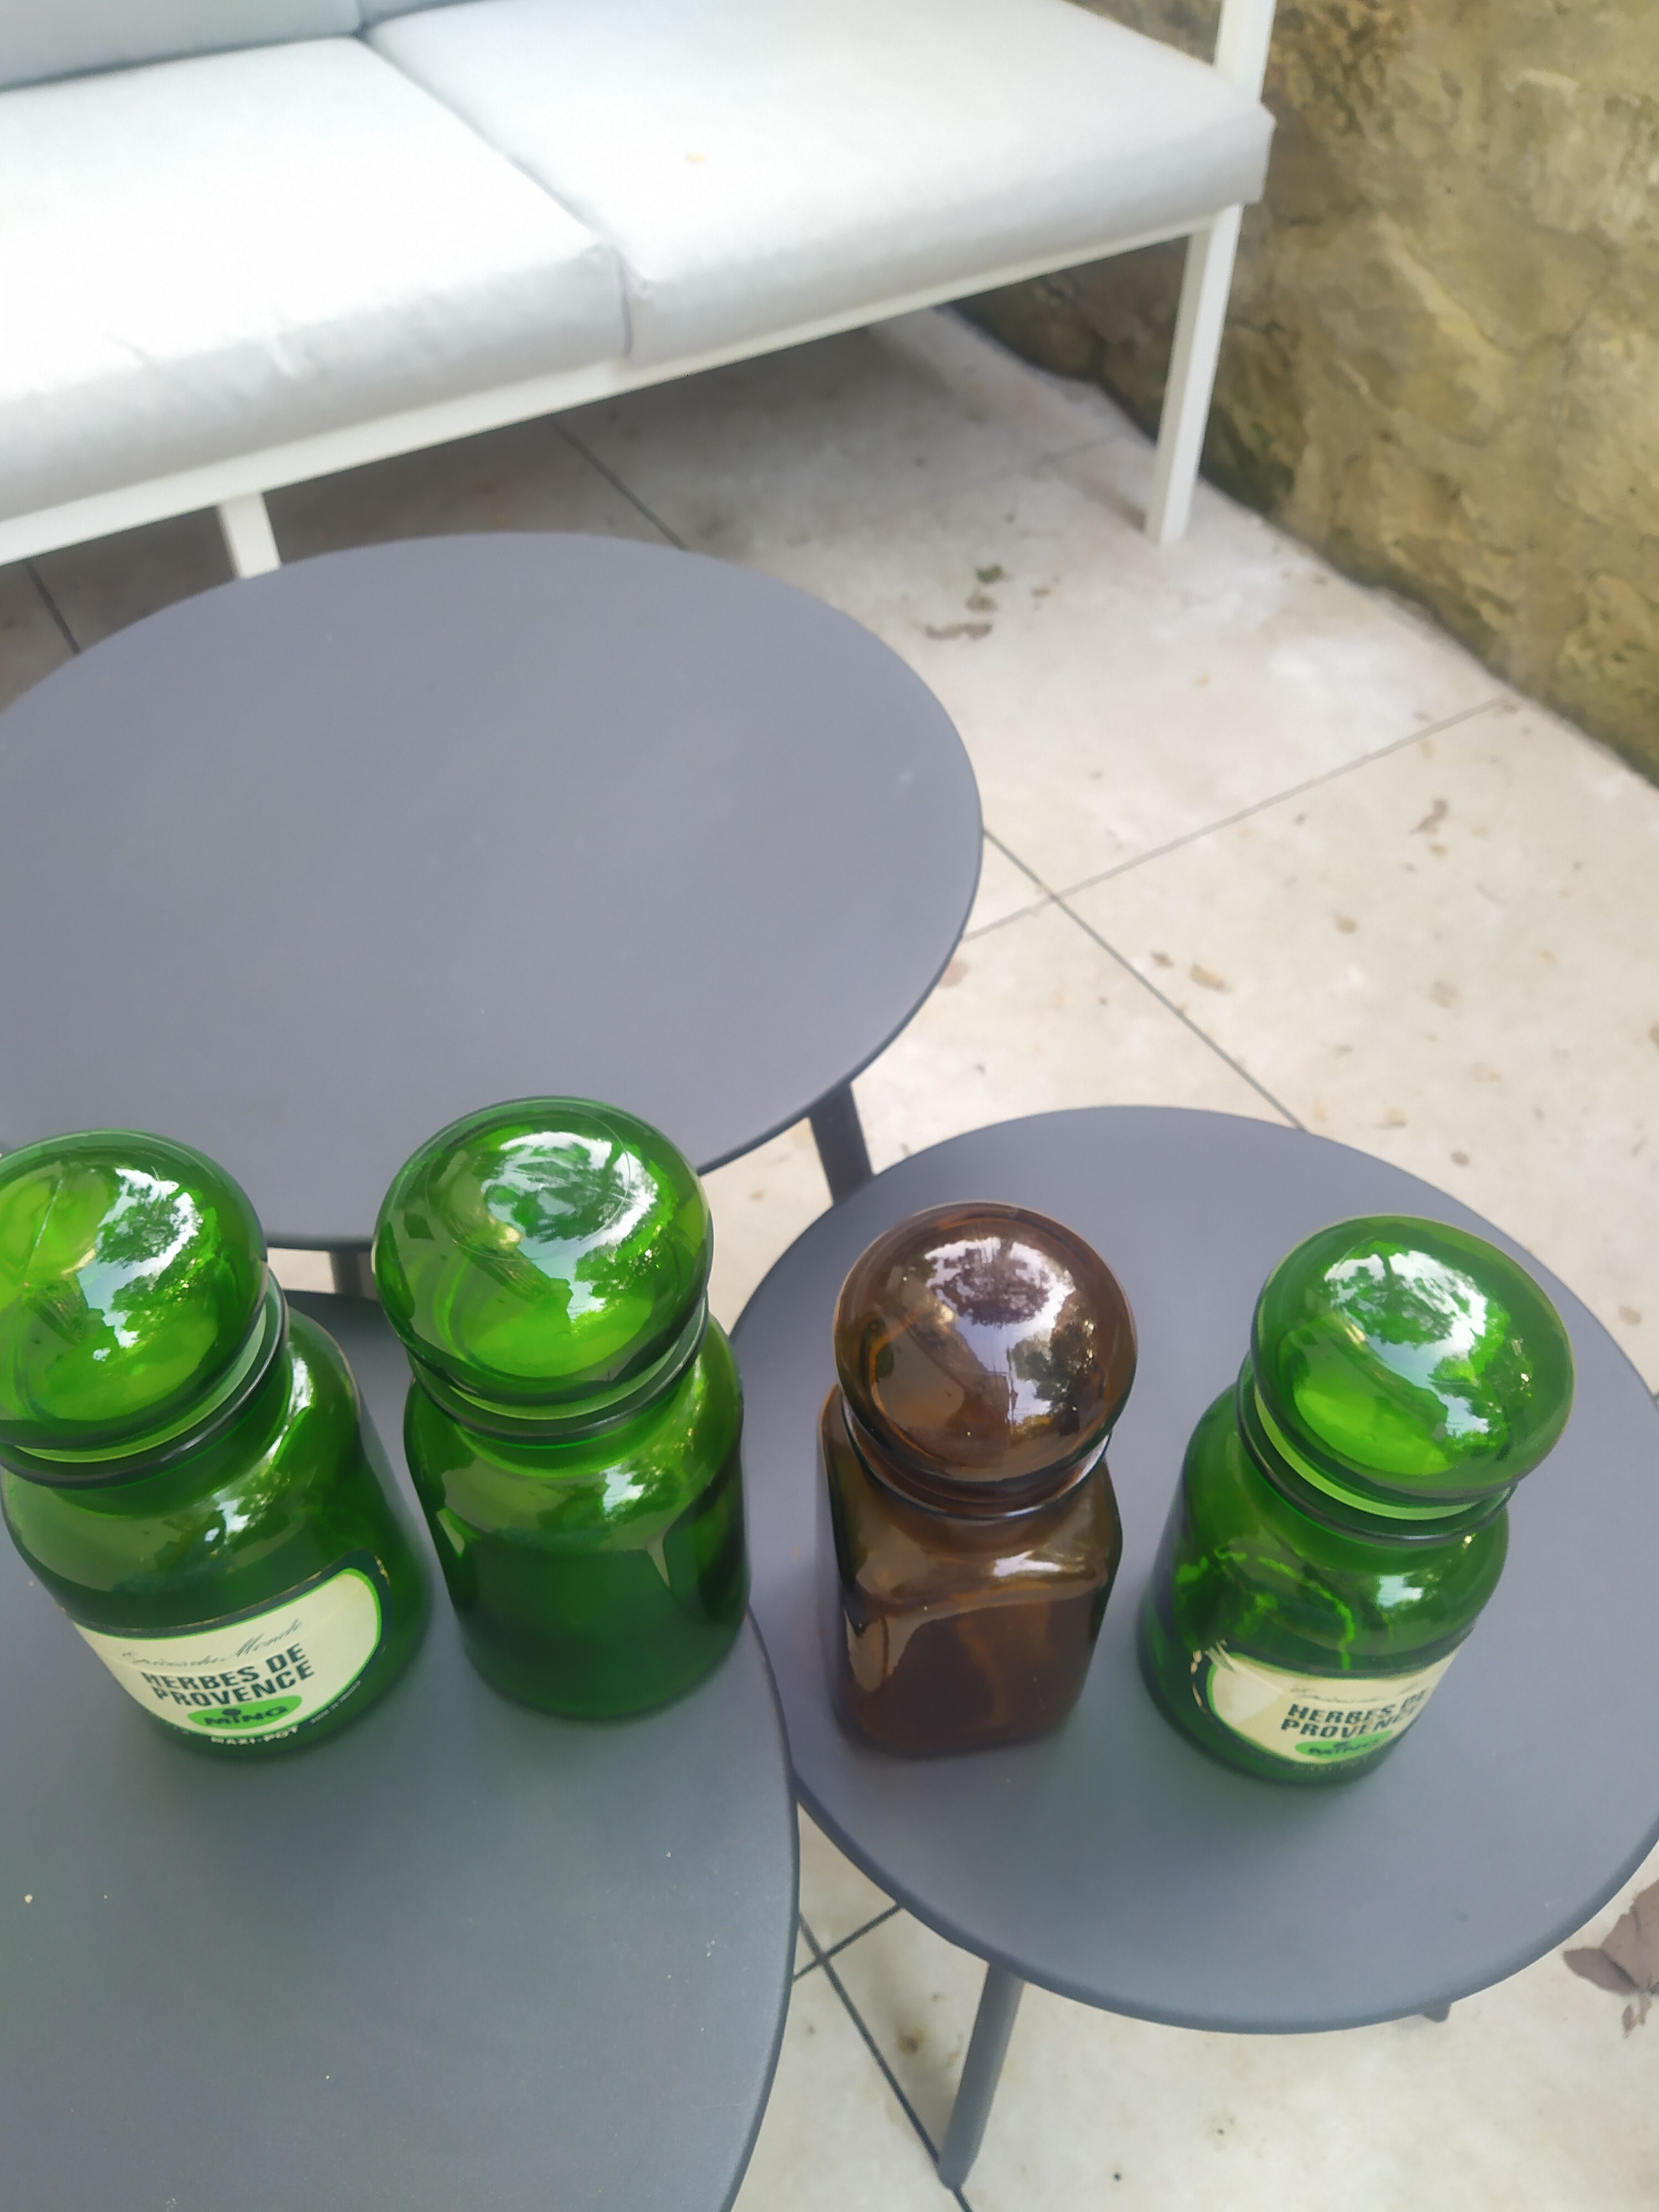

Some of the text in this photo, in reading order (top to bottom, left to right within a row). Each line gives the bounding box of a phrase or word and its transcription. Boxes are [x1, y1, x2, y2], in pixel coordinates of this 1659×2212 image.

[140, 1642, 306, 1691] HERBES DE
[153, 1660, 315, 1707] PROVENCE
[1287, 1703, 1396, 1725] HERBES
